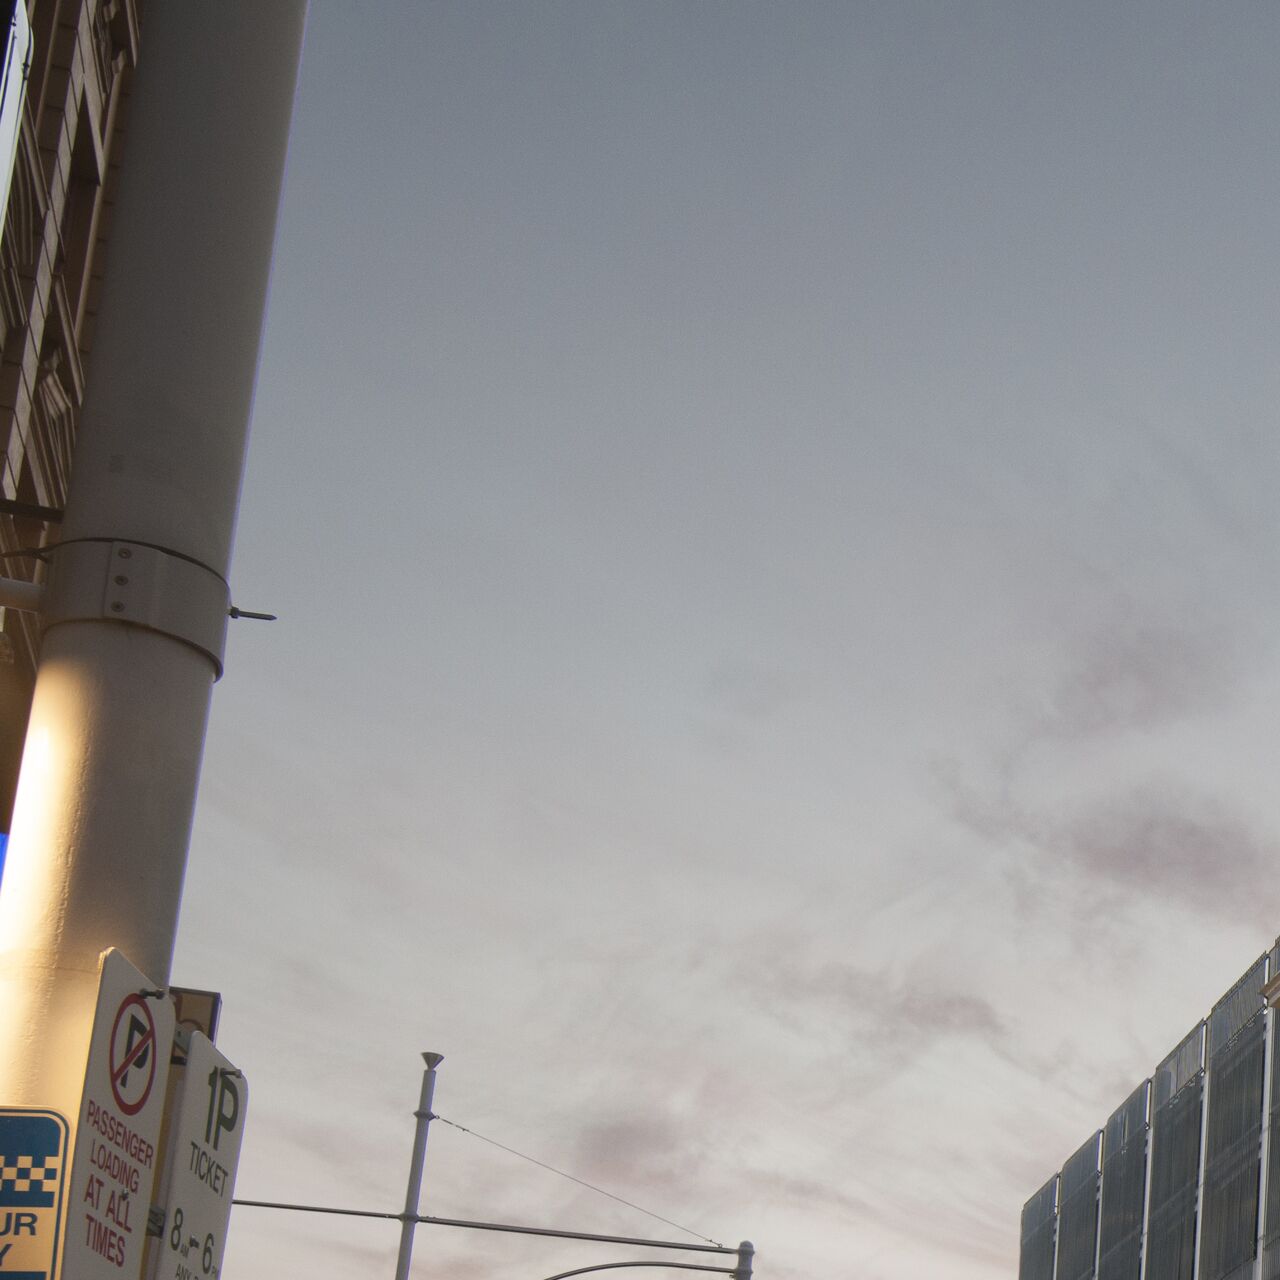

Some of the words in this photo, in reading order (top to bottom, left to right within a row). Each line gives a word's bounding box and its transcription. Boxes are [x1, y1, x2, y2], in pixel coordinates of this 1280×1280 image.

[86, 1100, 153, 1168] PASSENGER
[205, 1066, 239, 1151] 1P
[90, 1139, 140, 1194] LOADING
[190, 1141, 228, 1197] TICKET
[83, 1174, 104, 1208] AT
[105, 1189, 132, 1233] ALL
[85, 1214, 125, 1268] TIMES
